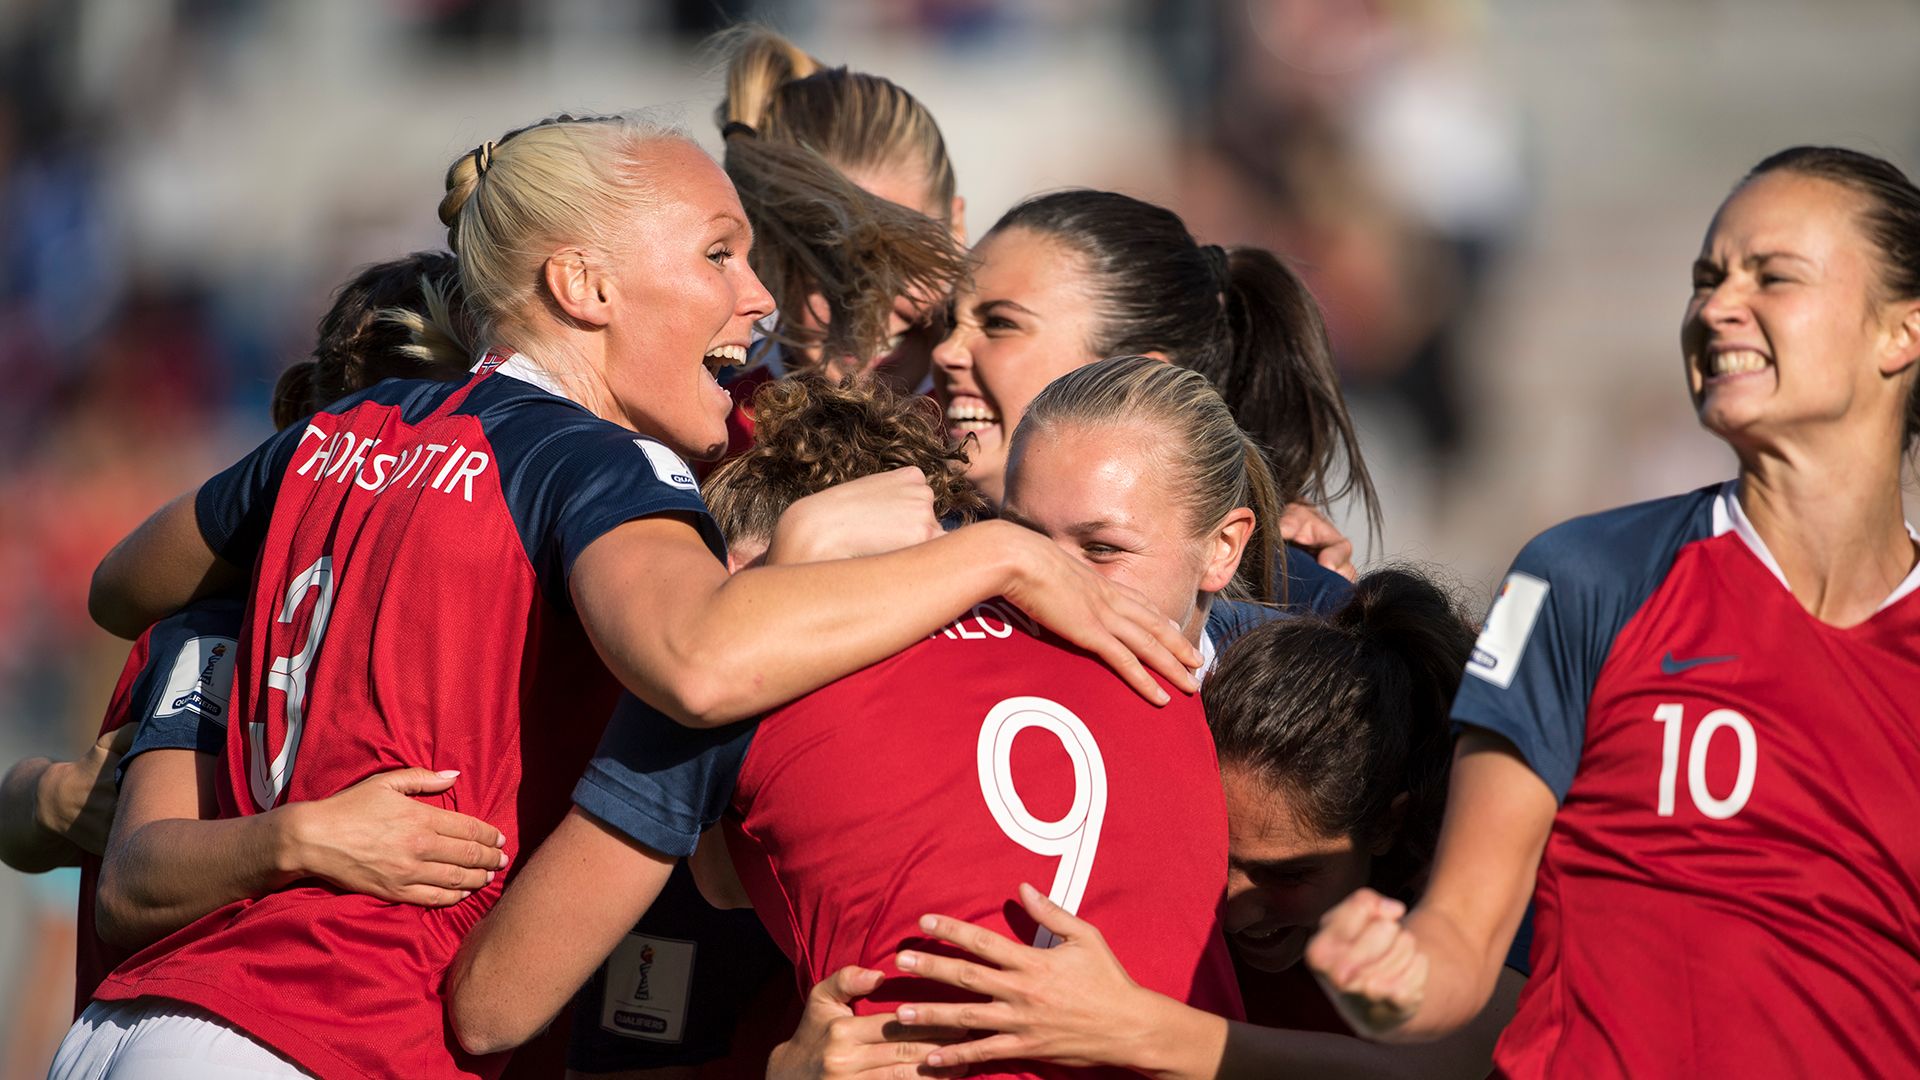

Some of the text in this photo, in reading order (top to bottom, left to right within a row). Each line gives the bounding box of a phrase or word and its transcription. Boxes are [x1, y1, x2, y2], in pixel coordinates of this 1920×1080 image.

[249, 555, 334, 811] 3
[1653, 703, 1758, 820] 10
[977, 696, 1107, 950] 9
